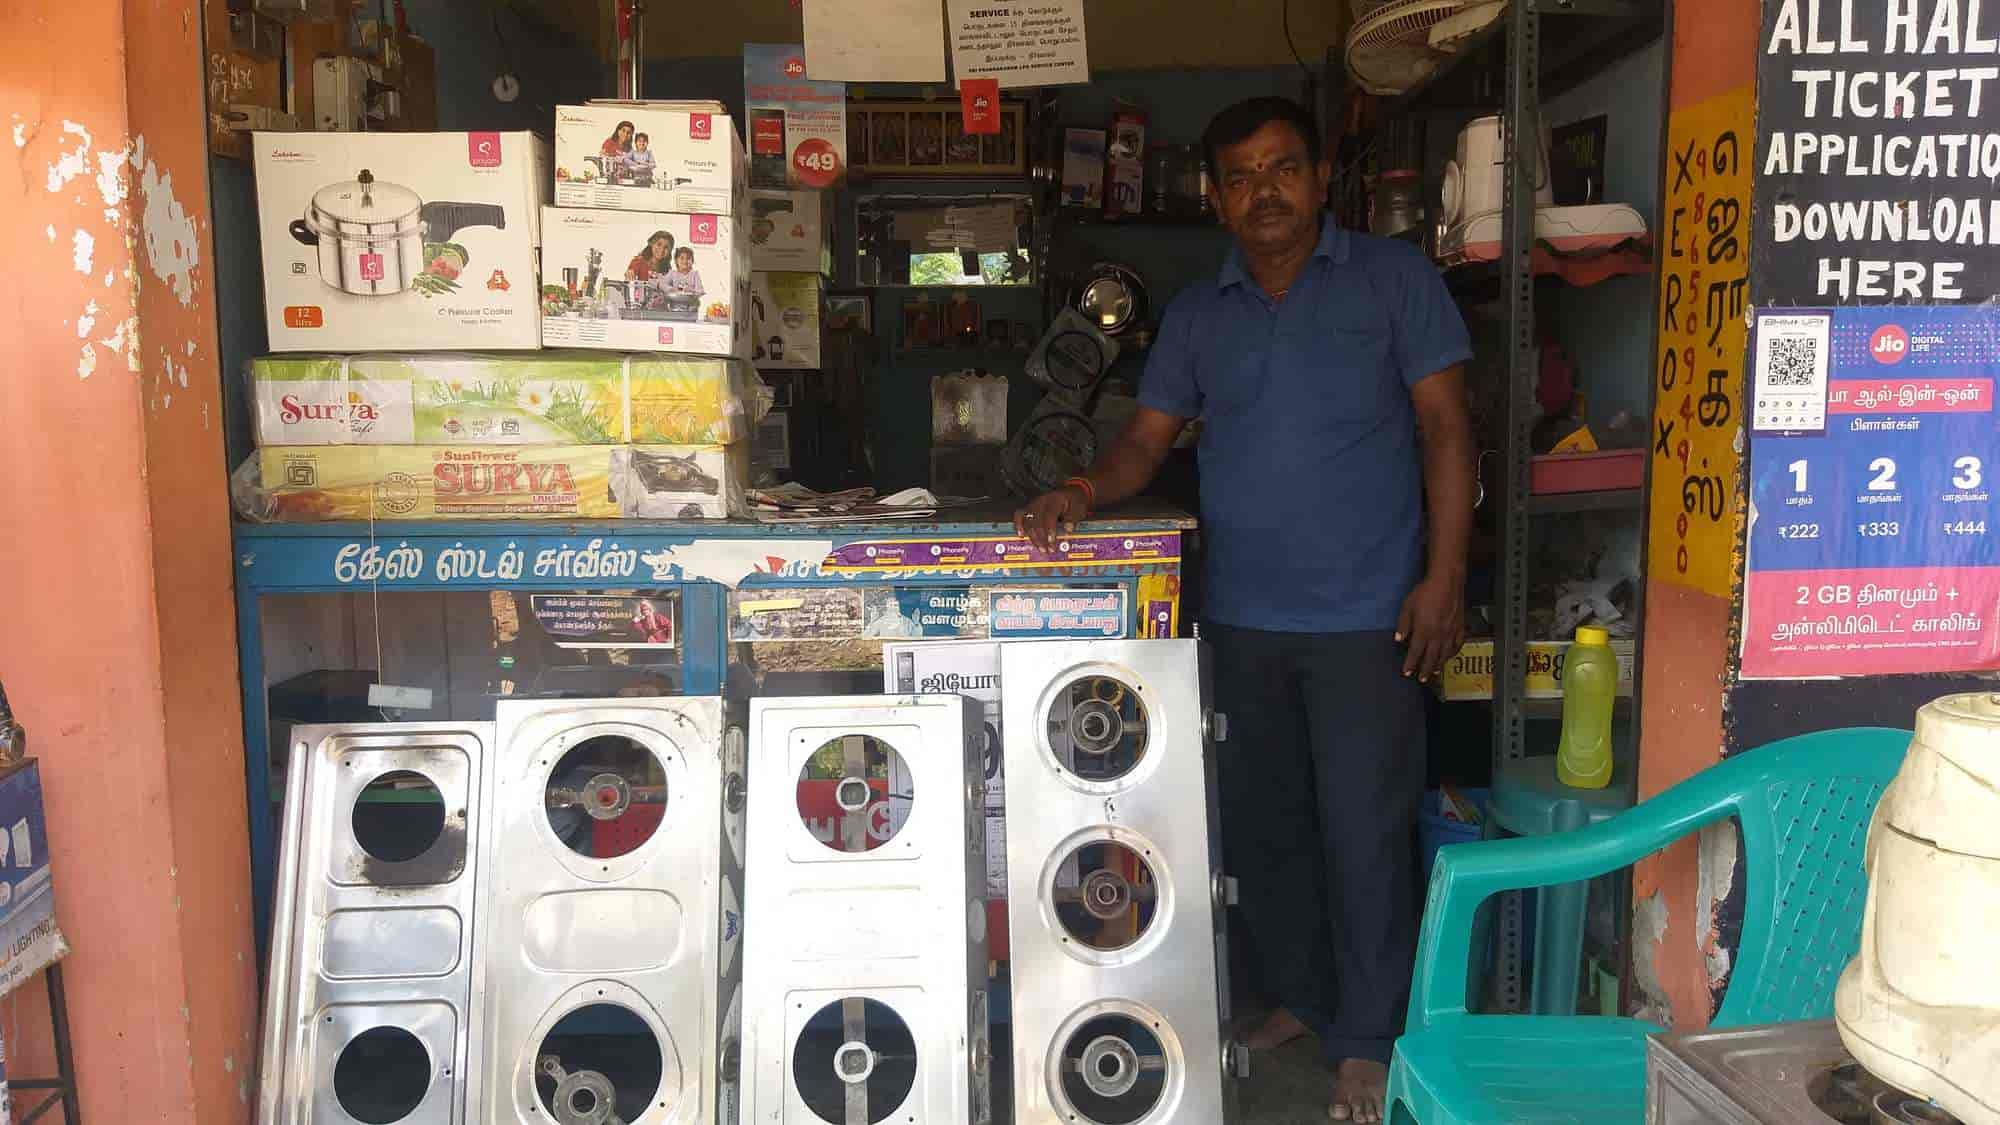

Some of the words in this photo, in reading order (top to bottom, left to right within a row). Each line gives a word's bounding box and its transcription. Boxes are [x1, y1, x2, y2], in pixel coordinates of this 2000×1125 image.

[969, 8, 1010, 18] SERVICE
[1767, 0, 1869, 54] ALL
[1884, 0, 2000, 54] HAL
[785, 62, 803, 73] Jio
[1791, 68, 1999, 119] TICKET
[797, 152, 834, 172] ₹49
[1816, 257, 1965, 299] HERE
[1654, 138, 1697, 459] XEROX
[297, 307, 311, 318] 12
[1874, 334, 1905, 353] Jio
[1911, 336, 1945, 344] DIGITAL
[1911, 344, 1930, 352] LIFE
[443, 450, 519, 462] Sunflower
[432, 463, 577, 495] SURYA
[1788, 459, 1809, 493] 1
[1868, 457, 1897, 490] 2
[1952, 456, 1982, 489] 3
[1777, 523, 1820, 539] ₹222
[1858, 521, 1900, 537] ₹333
[1943, 520, 1987, 537] ₹444
[334, 540, 424, 582] கேஸ்
[533, 538, 637, 578] சர்வீஸ்
[928, 592, 982, 611] வாழ்க
[1796, 586, 1810, 605] 2
[1817, 585, 1852, 605] GB
[1857, 582, 1938, 609] தினமும்
[1945, 587, 1960, 602] +
[1771, 613, 1905, 641] அன்லிமிடெட்
[1911, 612, 1981, 634] காலிங்
[921, 672, 1001, 694] ஜியோ
